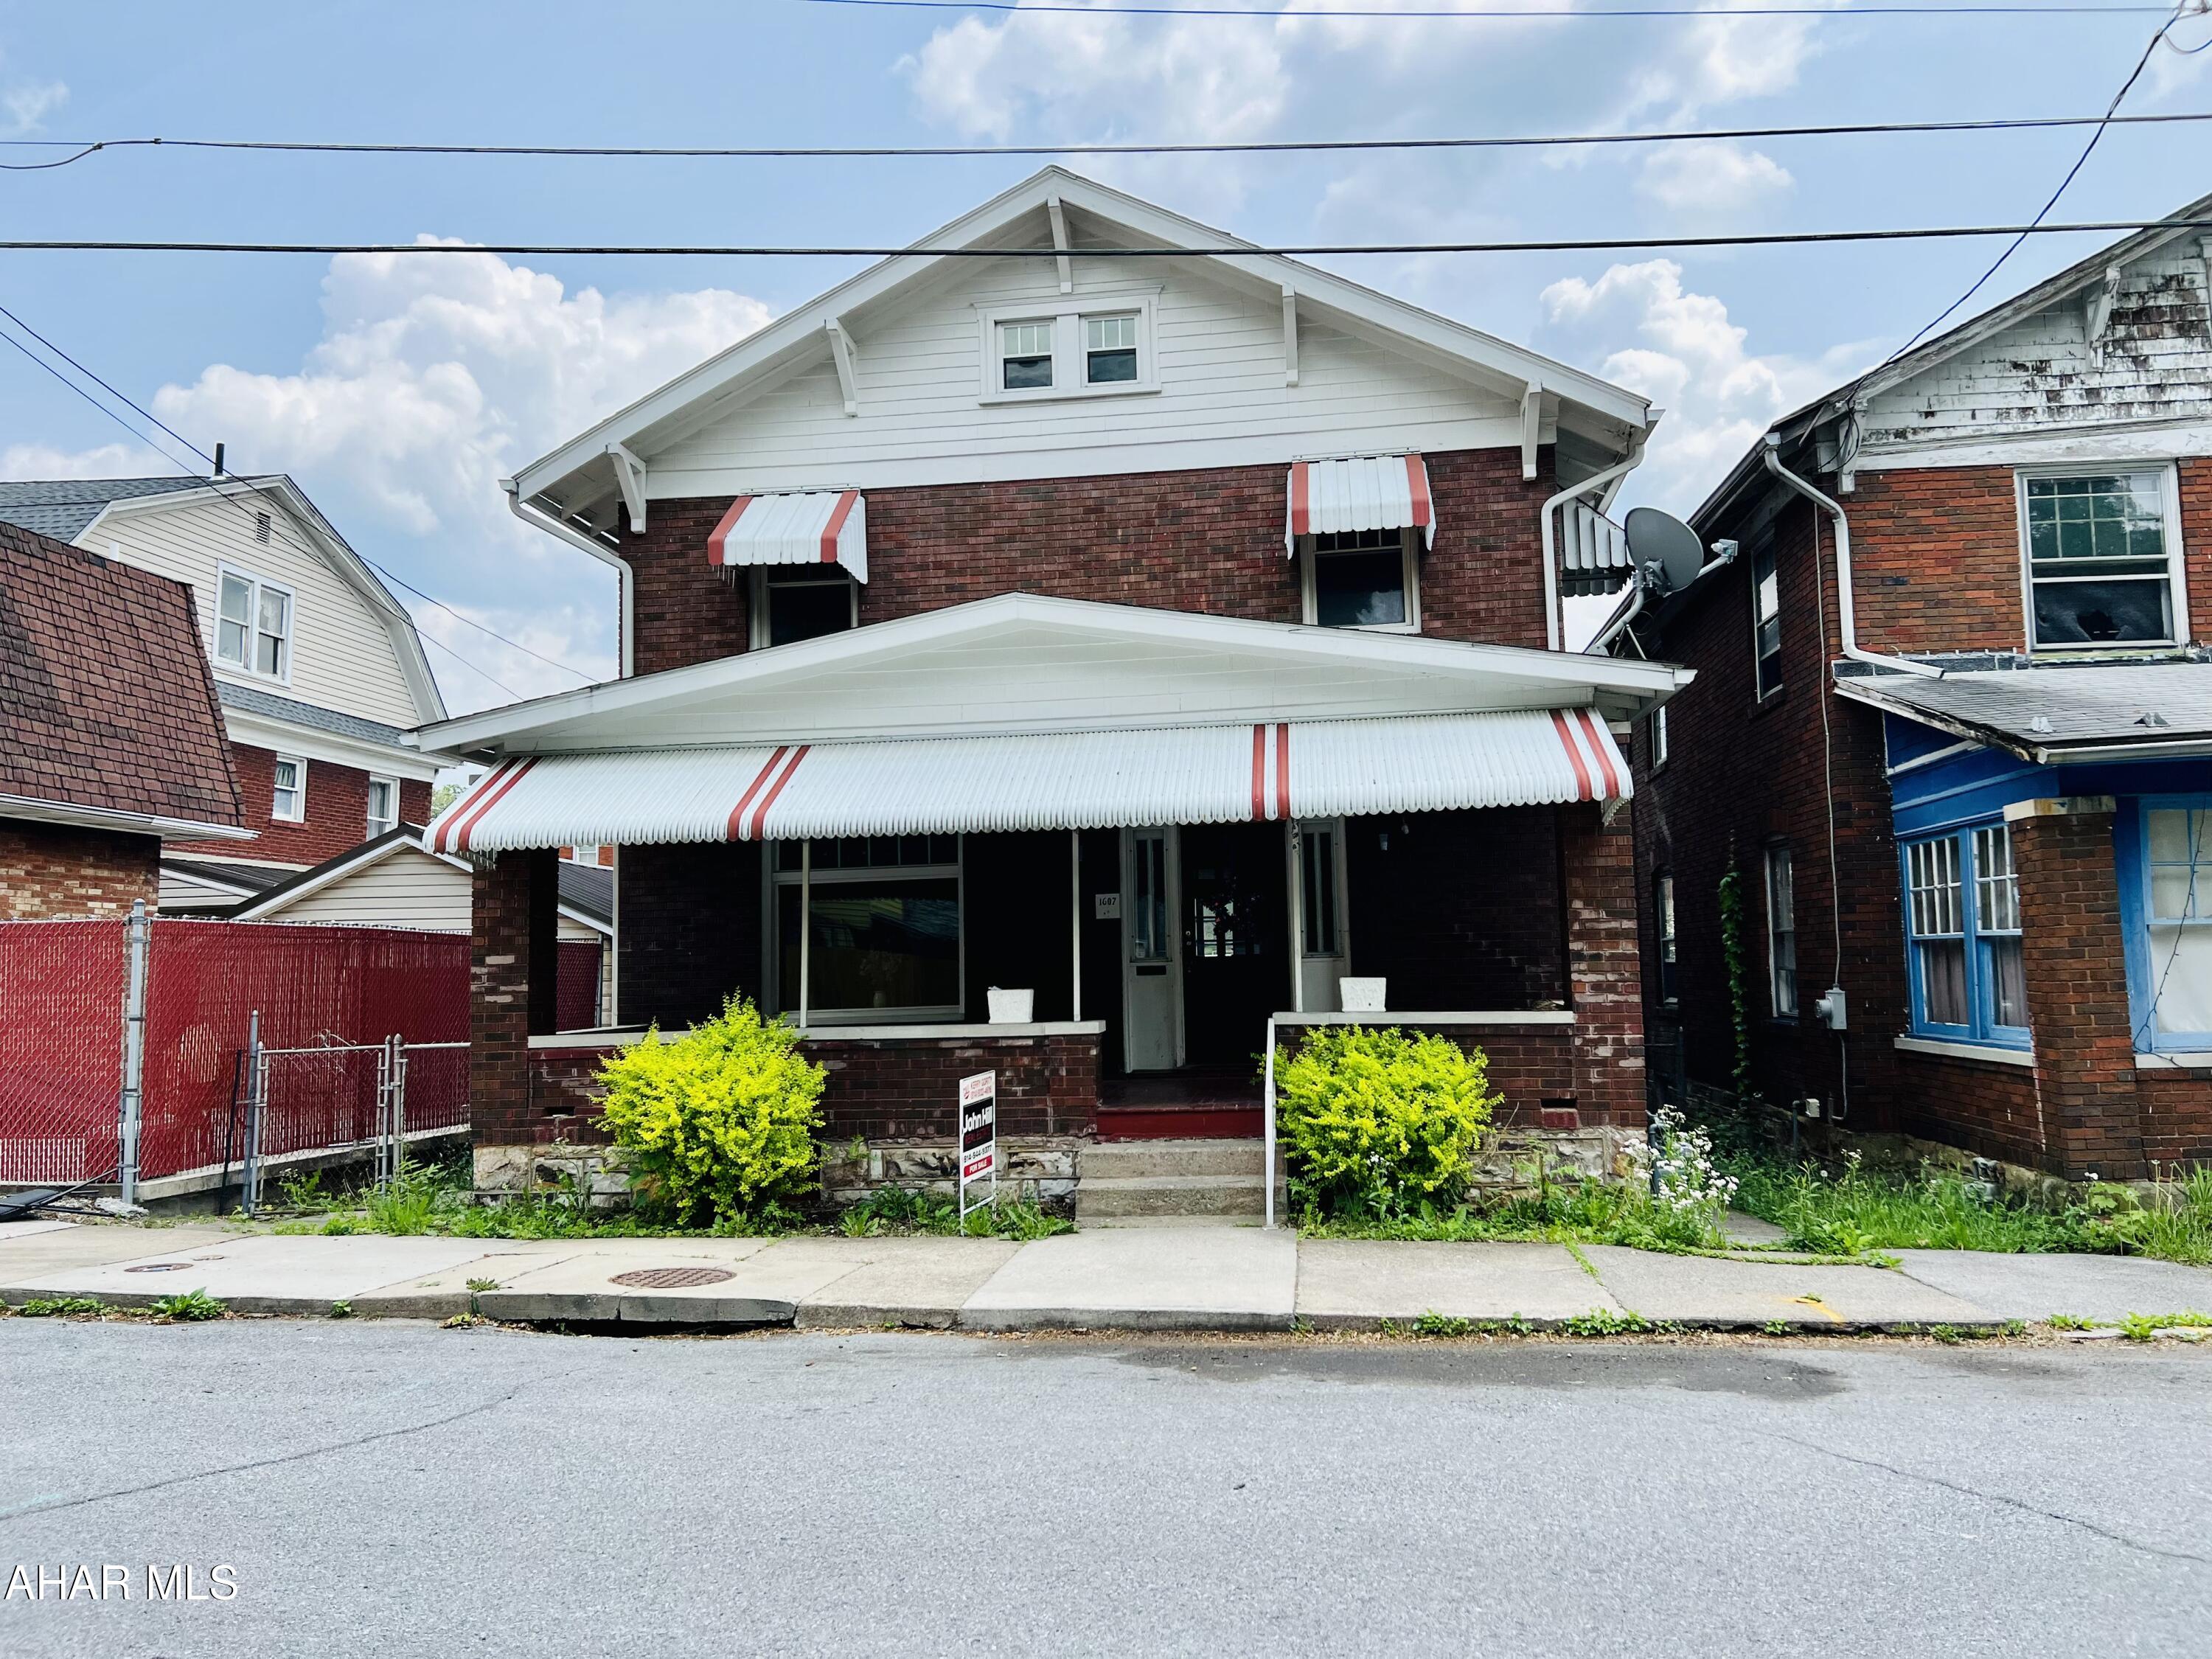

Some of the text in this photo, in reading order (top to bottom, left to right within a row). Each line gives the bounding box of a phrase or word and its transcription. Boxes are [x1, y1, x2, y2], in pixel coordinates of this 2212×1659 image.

[1099, 897, 1116, 905] 1607
[962, 1106, 992, 1134] John Hill
[969, 1158, 987, 1173] FOR SALE
